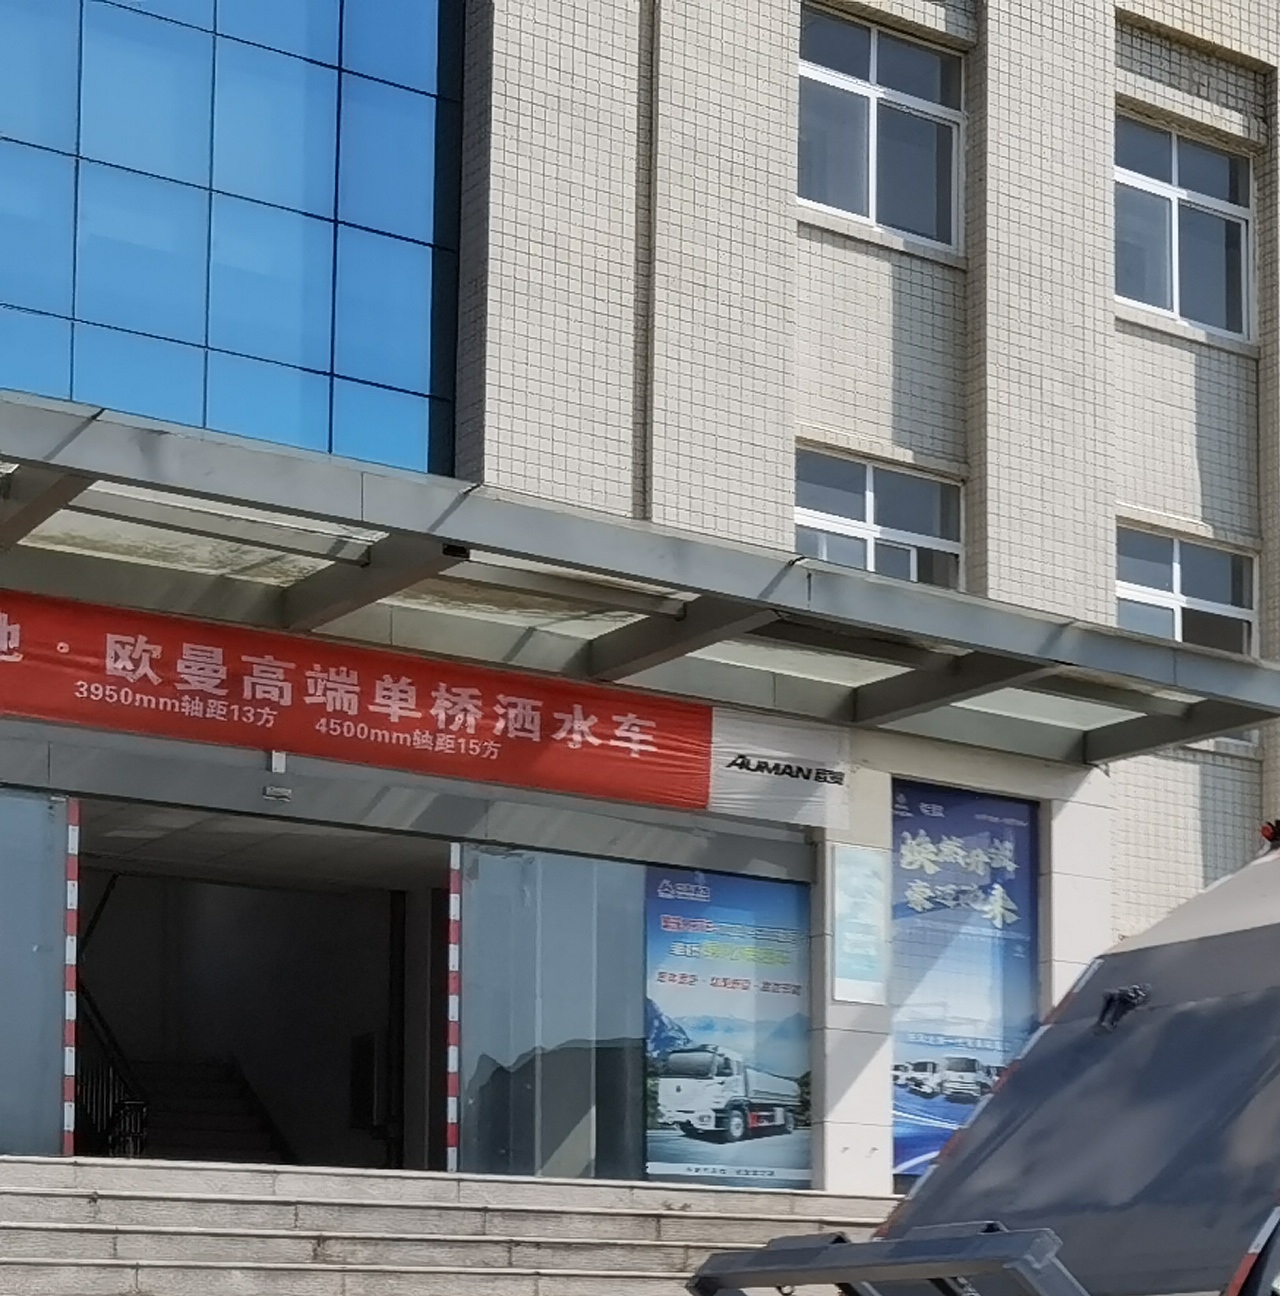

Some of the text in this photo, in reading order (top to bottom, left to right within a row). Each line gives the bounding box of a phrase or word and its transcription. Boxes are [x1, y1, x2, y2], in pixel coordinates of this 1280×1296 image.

[75, 681, 501, 760] 3950mm轴距13方 4500mm轴距15方
[725, 755, 812, 780] AUMAN
